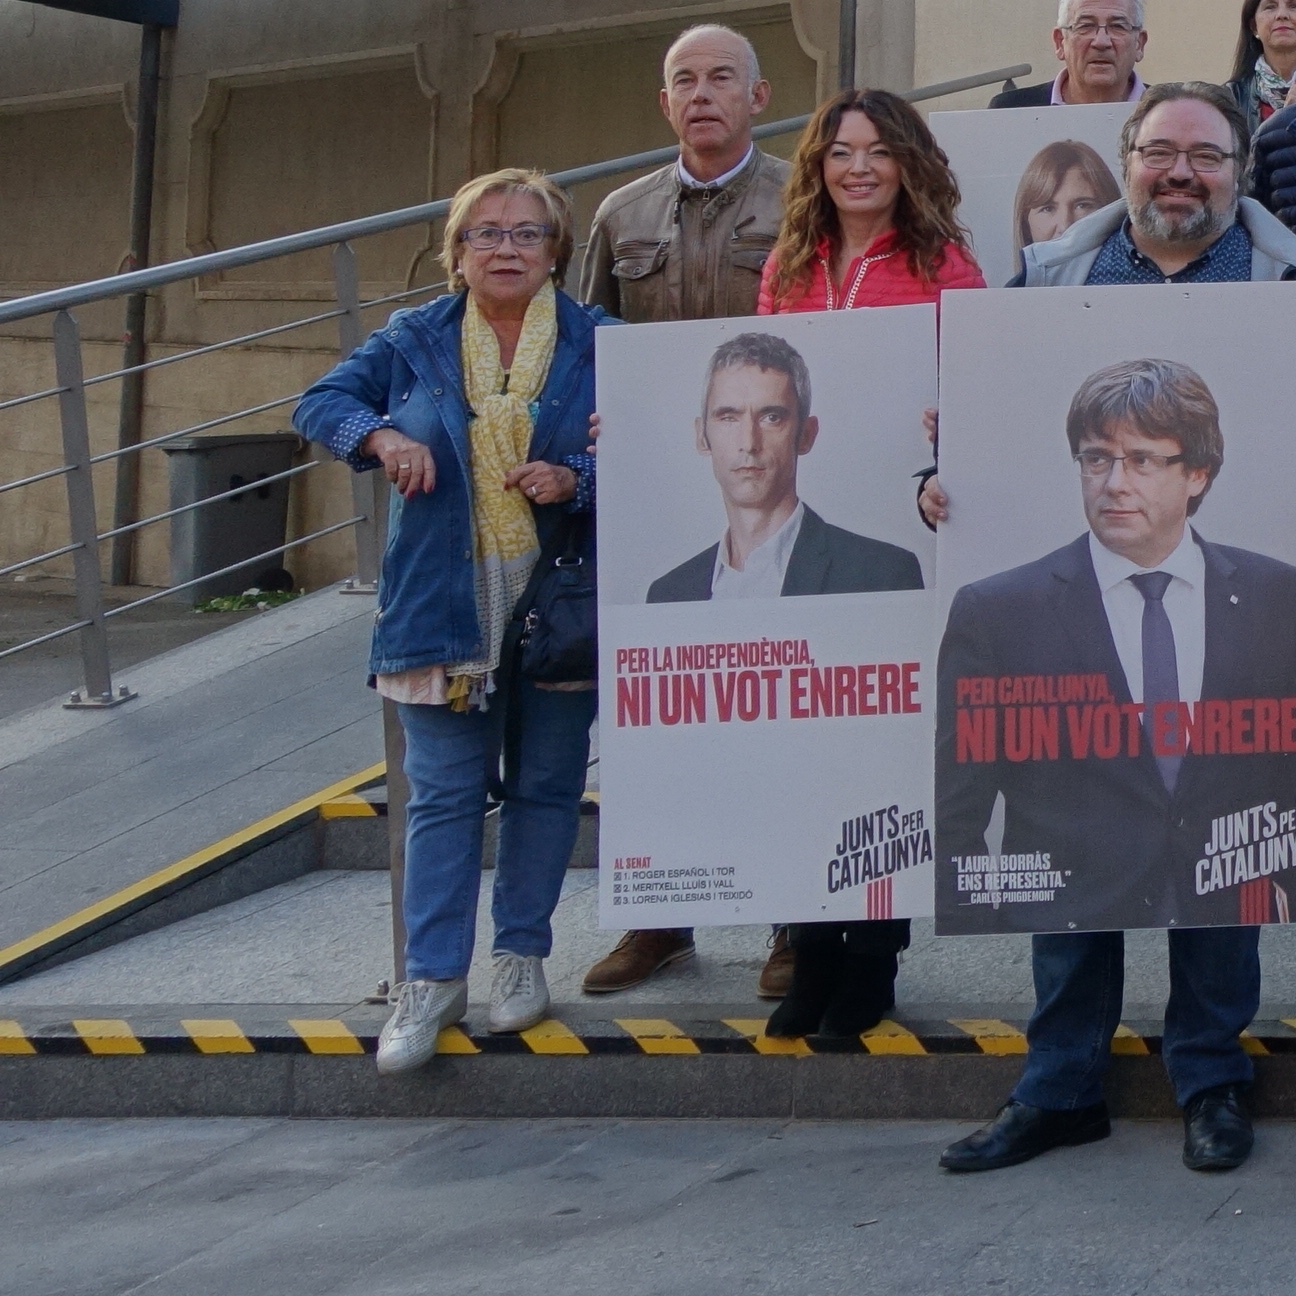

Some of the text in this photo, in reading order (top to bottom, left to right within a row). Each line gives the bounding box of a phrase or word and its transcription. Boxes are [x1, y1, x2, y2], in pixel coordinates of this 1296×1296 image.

[616, 636, 814, 674] PER LA INDEPENDÈNCIA,
[617, 662, 922, 727] NI UN VOT ENRERE
[957, 672, 1115, 704] PER CATALUNYA,
[956, 707, 997, 763] NI
[1004, 705, 1059, 762] UN
[1067, 702, 1145, 760] VOT
[836, 804, 924, 856] JUNTS PER
[1204, 801, 1277, 856] JUNTS
[614, 857, 651, 870] AL SENAT
[632, 869, 665, 880] ROGER
[668, 867, 710, 879] ESPAÑOL
[717, 867, 735, 876] TOR
[828, 829, 932, 893] CATALUNYA
[1000, 850, 1051, 871] BORRÀS
[632, 882, 680, 892] MERITXELL
[682, 879, 706, 890] LLUÍS
[713, 879, 734, 888] VALL
[957, 873, 982, 891] ENS
[632, 894, 668, 904] LORENA
[670, 891, 711, 902] IGLESIAS
[718, 890, 753, 900] TEIXIDÓ
[970, 890, 1055, 904] CARLES PUIGDEMONT
